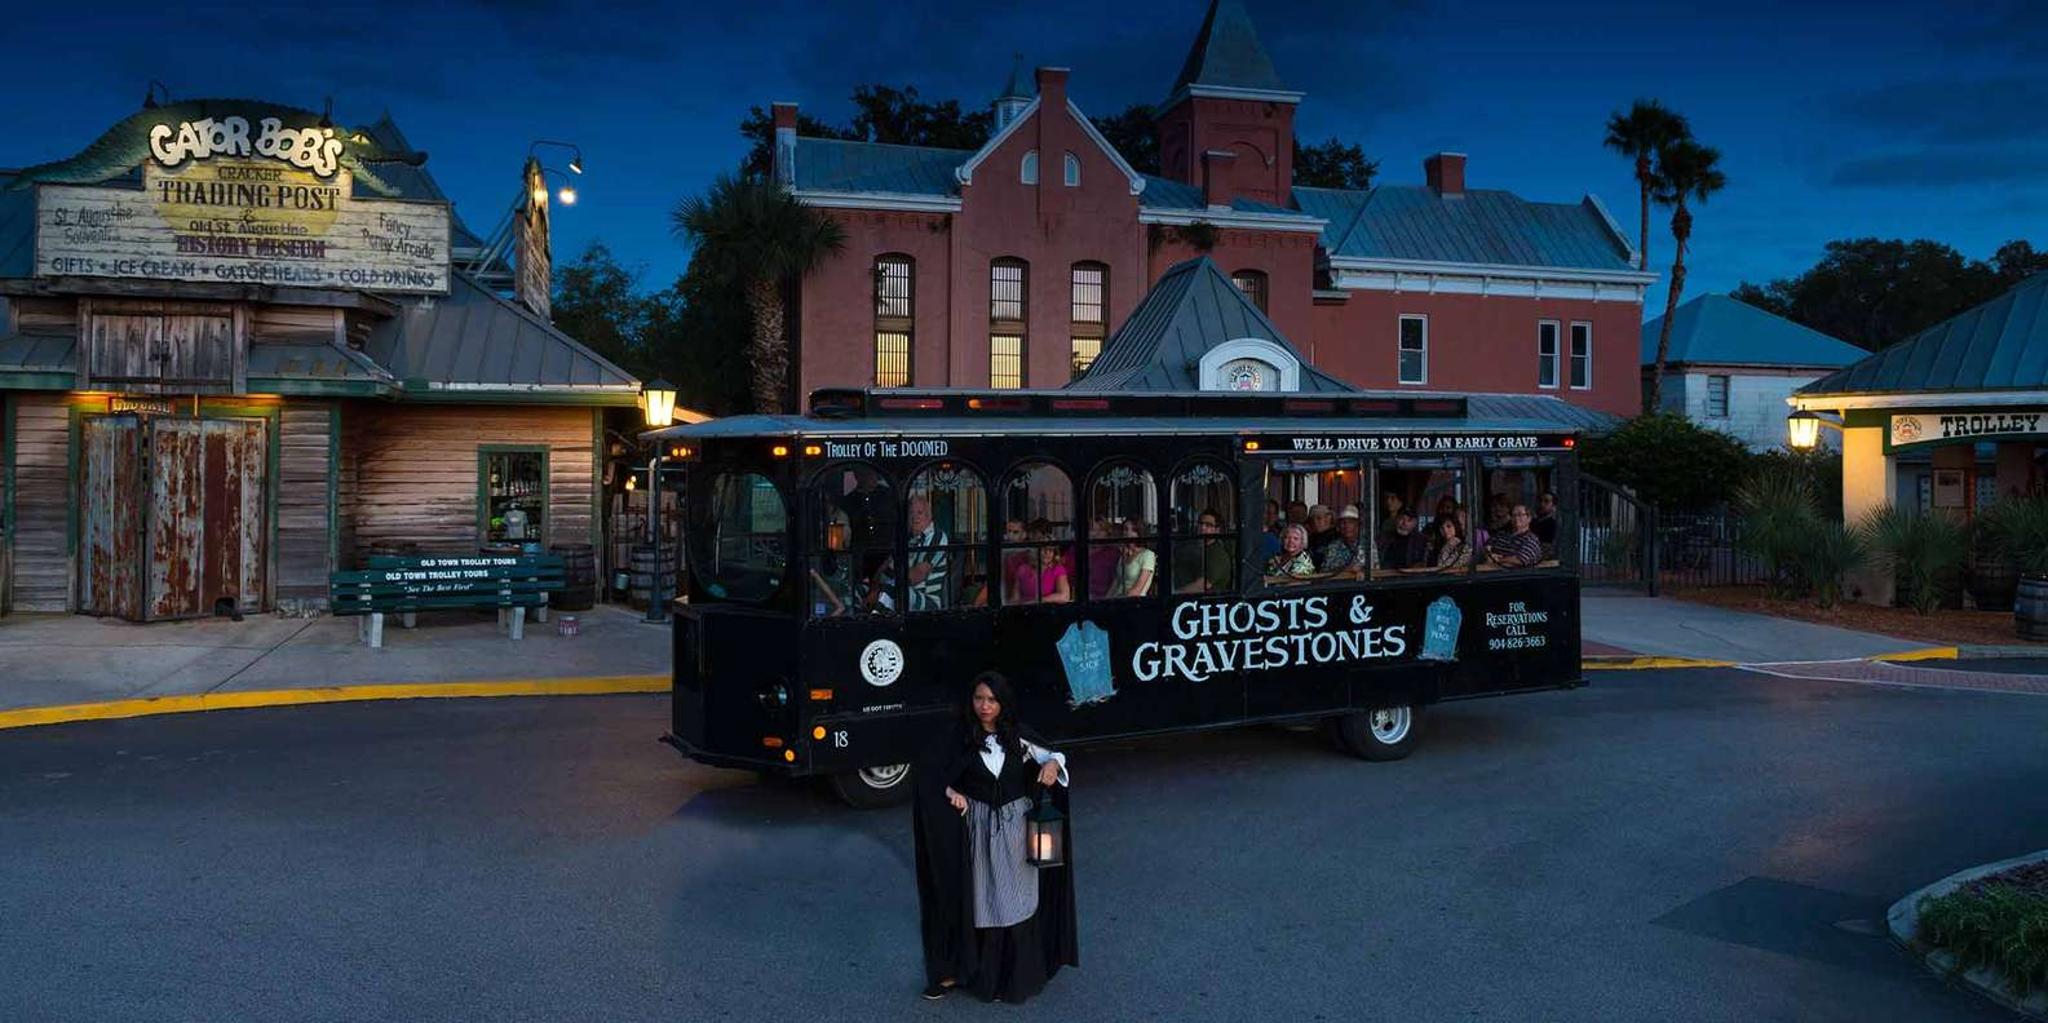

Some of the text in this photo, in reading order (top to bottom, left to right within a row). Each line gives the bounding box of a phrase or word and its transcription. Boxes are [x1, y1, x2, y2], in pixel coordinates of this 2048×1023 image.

[150, 116, 251, 166] GATOR
[218, 167, 282, 181] CRACKER
[158, 181, 340, 210] TRADING POST
[238, 222, 308, 236] Augustine
[52, 258, 94, 273] GIFTS
[113, 260, 136, 274] ICE
[141, 261, 195, 276] CREAM
[340, 269, 379, 284] COLD
[382, 271, 435, 287] DRINKS
[1940, 414, 2040, 437] TROLLEY
[824, 440, 948, 458] TROLLEY OF THE DOOMED
[1292, 437, 1538, 450] WE'LL DRIVE YOU TO AN EARLY GRAVE
[420, 558, 517, 567] OLD TOWN TROLLEY TOURS
[385, 570, 489, 581] OLD TOWN TROLLEY TOURS
[1509, 601, 1526, 612] FOR
[1171, 594, 1374, 641] GHOSTS &
[1486, 611, 1549, 628] RESERVATIONS
[1506, 624, 1528, 636] CALL
[1132, 624, 1406, 682] GRAVESTONES
[833, 730, 849, 748] 18
